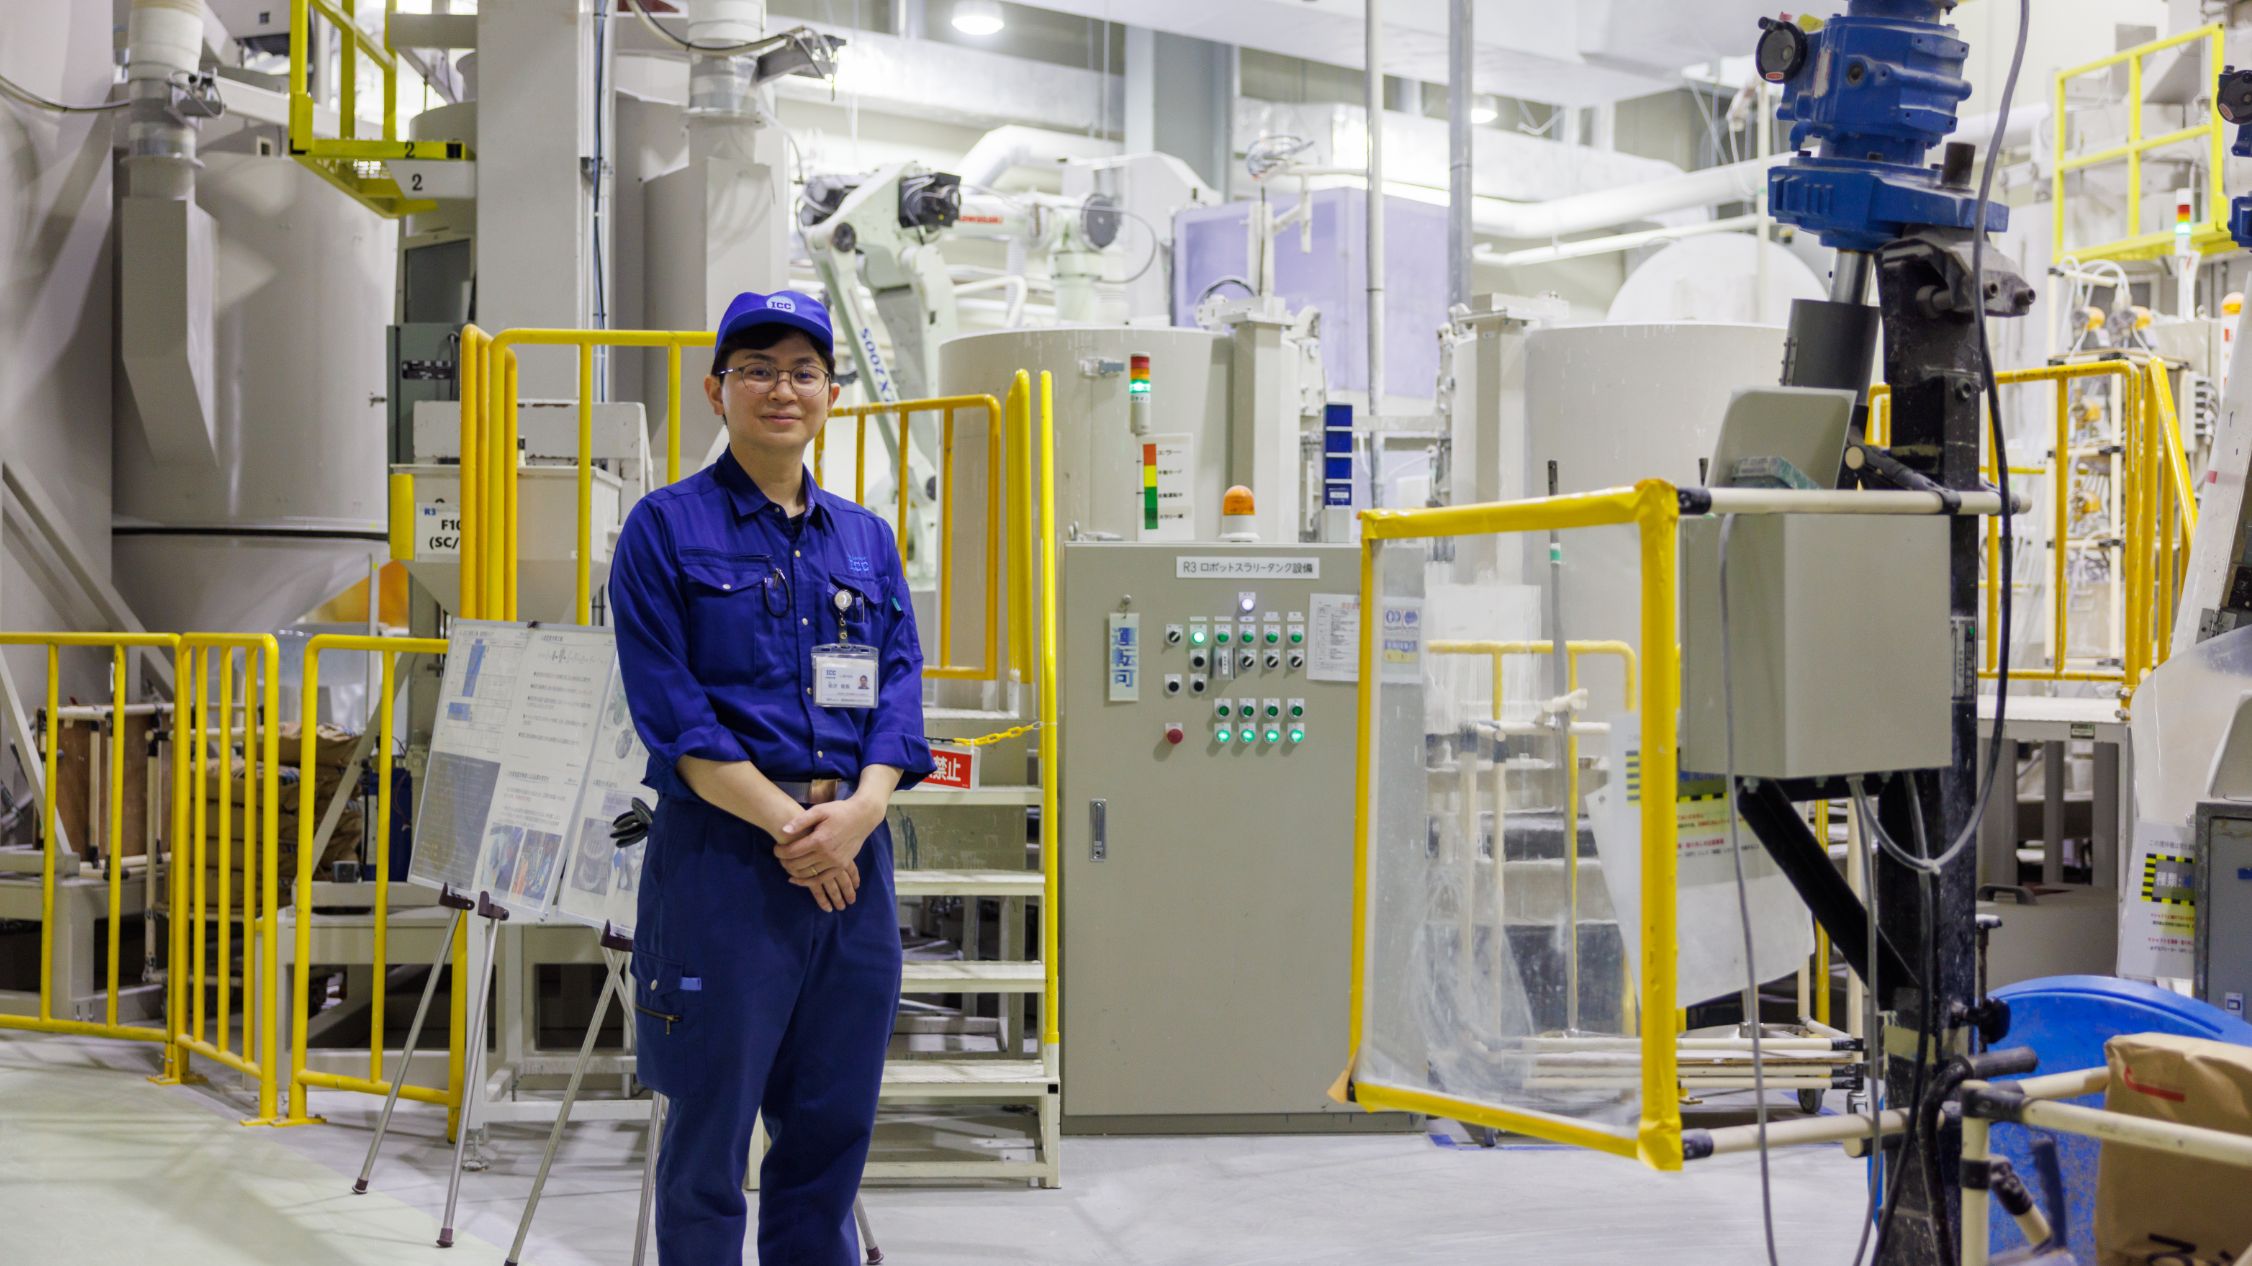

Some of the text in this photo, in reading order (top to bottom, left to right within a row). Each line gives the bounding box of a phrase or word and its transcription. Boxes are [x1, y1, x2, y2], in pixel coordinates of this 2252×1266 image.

[404, 141, 416, 159] 2
[411, 173, 423, 191] 2
[770, 301, 792, 310] ICC
[423, 507, 437, 516] R3
[429, 536, 459, 550] (SC/
[849, 559, 870, 572] ICC
[1182, 561, 1313, 574] R3 ロボットスラリータンク設備
